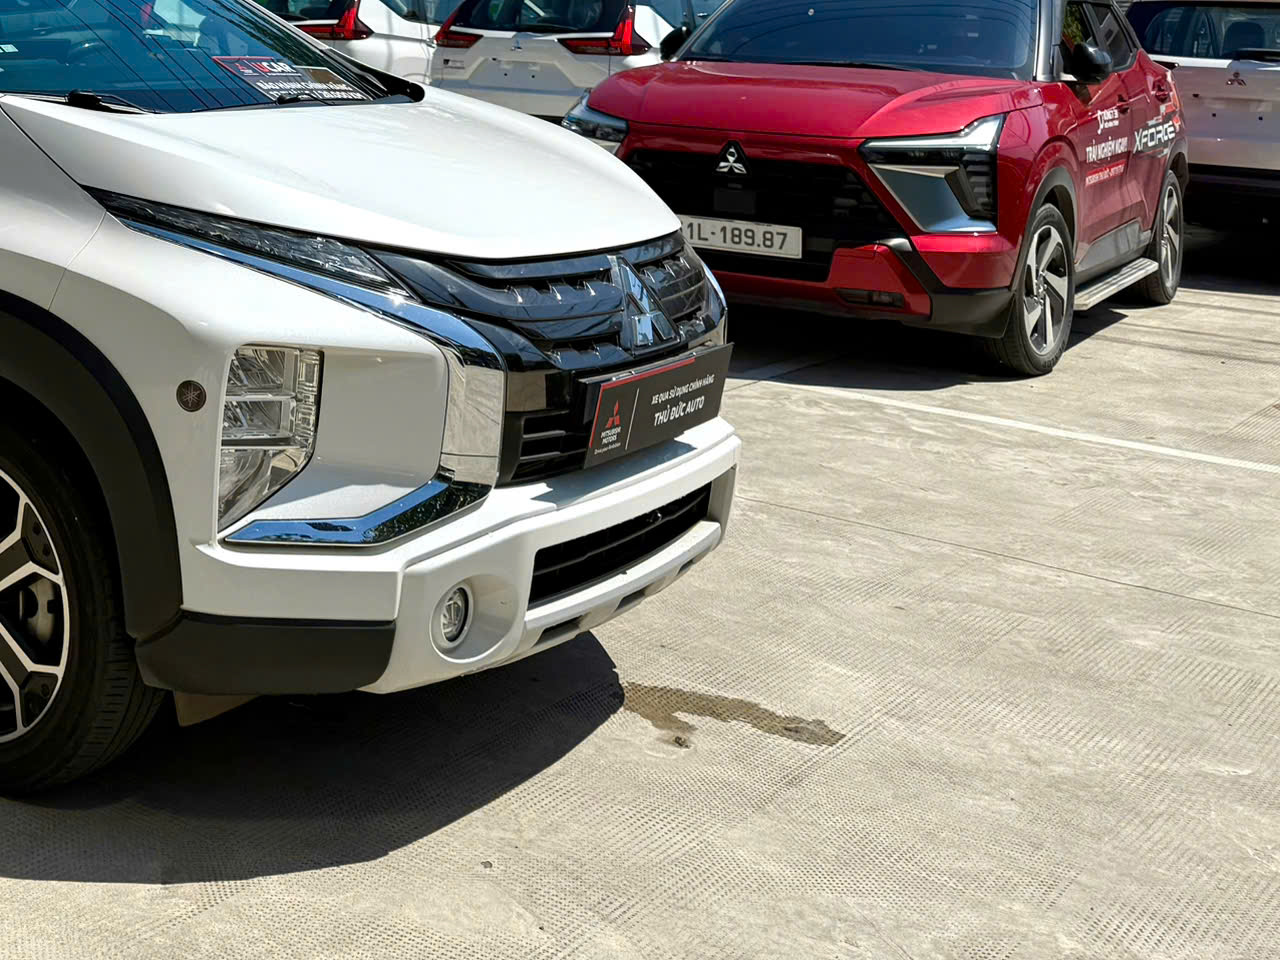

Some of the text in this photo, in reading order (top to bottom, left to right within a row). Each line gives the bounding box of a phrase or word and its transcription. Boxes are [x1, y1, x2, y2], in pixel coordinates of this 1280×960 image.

[251, 62, 297, 73] UCAR
[1133, 121, 1176, 154] XFORCE
[680, 221, 788, 250] 1L-189.87
[651, 394, 660, 405] XE
[658, 390, 669, 404] QUA
[654, 395, 705, 426] THỦ ĐỨC AUTO
